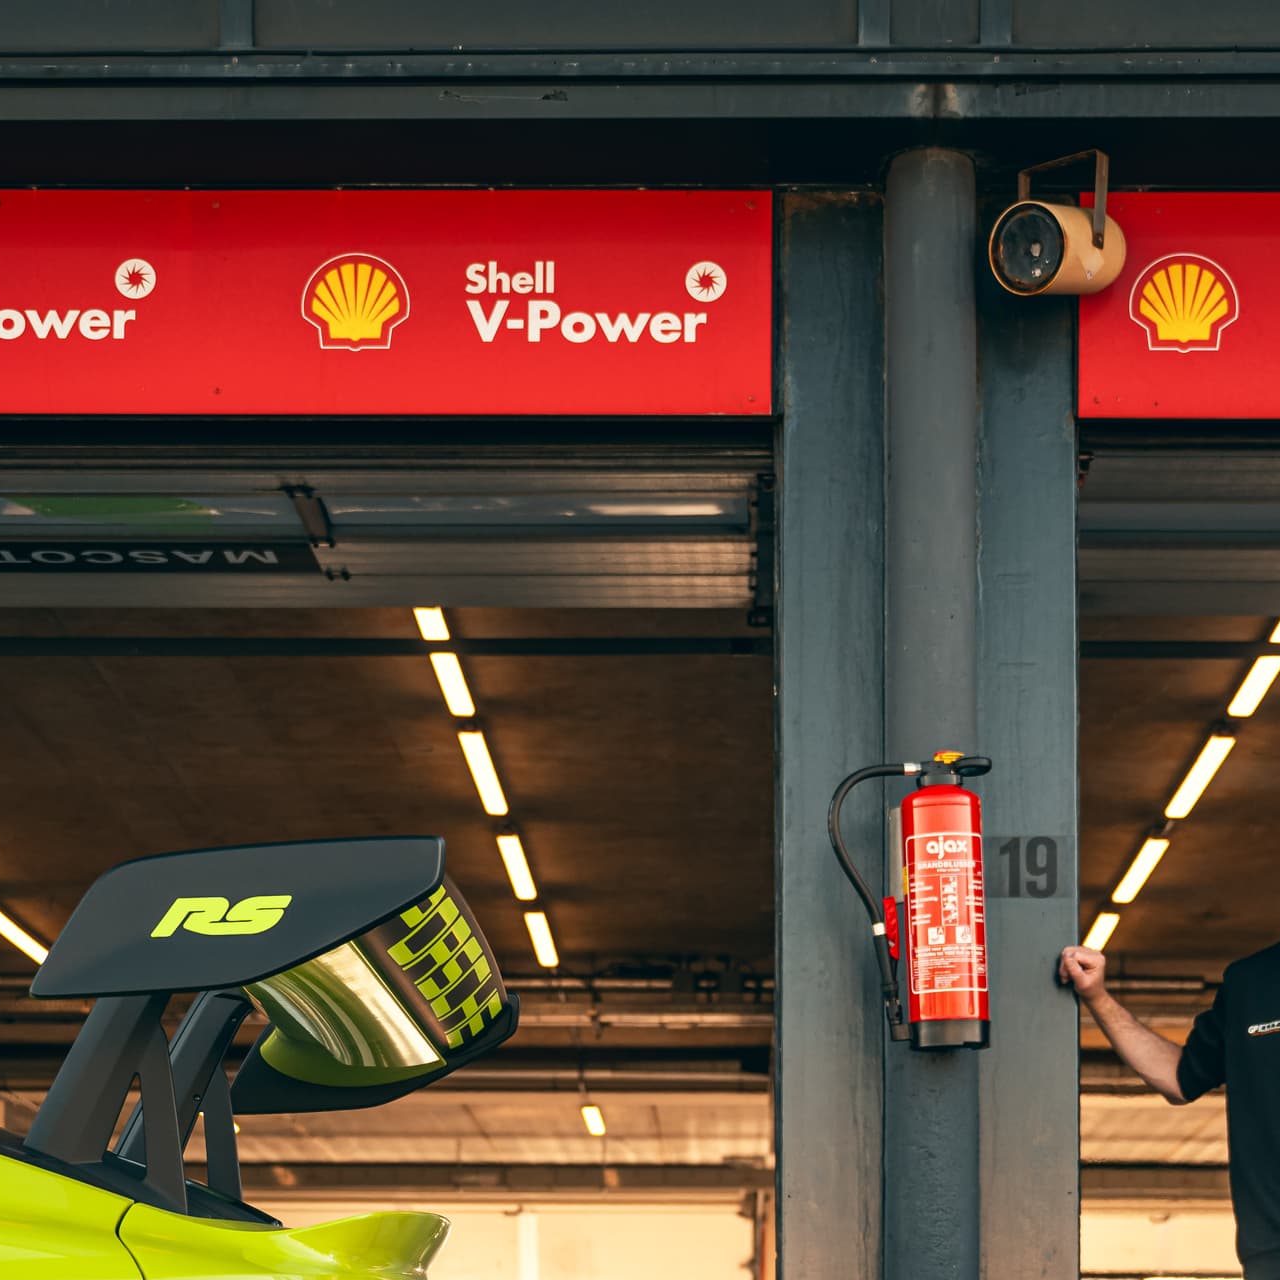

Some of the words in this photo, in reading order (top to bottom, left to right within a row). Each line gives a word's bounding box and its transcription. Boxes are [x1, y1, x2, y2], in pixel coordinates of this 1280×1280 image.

[465, 261, 555, 294] Shell
[465, 300, 707, 344] V-Power
[926, 836, 967, 859] ajax
[998, 836, 1058, 899] 19
[151, 895, 293, 938] RS
